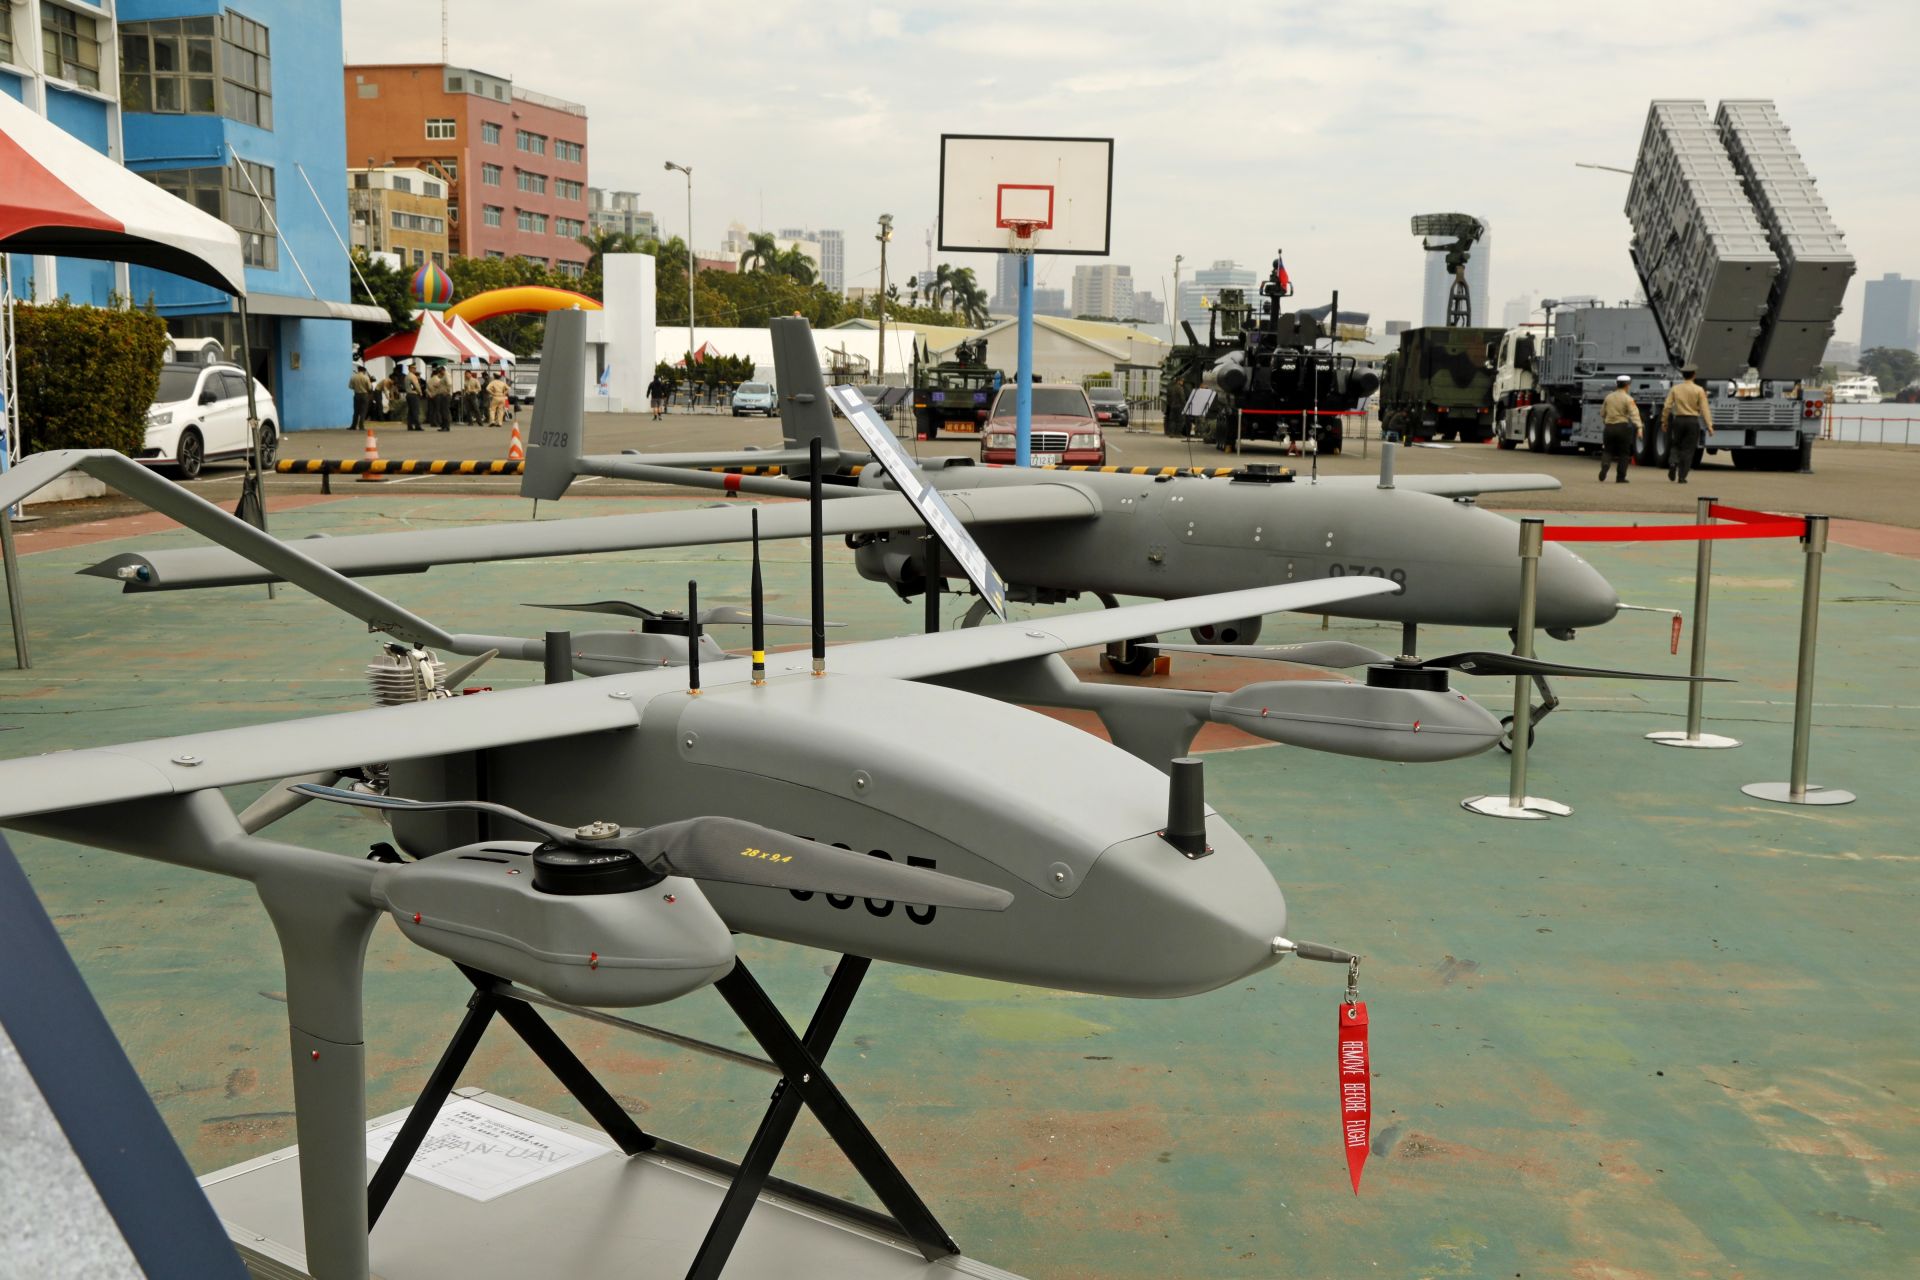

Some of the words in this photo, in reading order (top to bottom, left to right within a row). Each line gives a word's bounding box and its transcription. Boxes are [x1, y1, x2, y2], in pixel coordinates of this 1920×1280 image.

[541, 431, 569, 448] 9728
[740, 847, 761, 857] 28
[1342, 1041, 1365, 1075] REMOVE
[1344, 1083, 1367, 1113] BEFORE
[1346, 1119, 1367, 1147] FLIGHT
